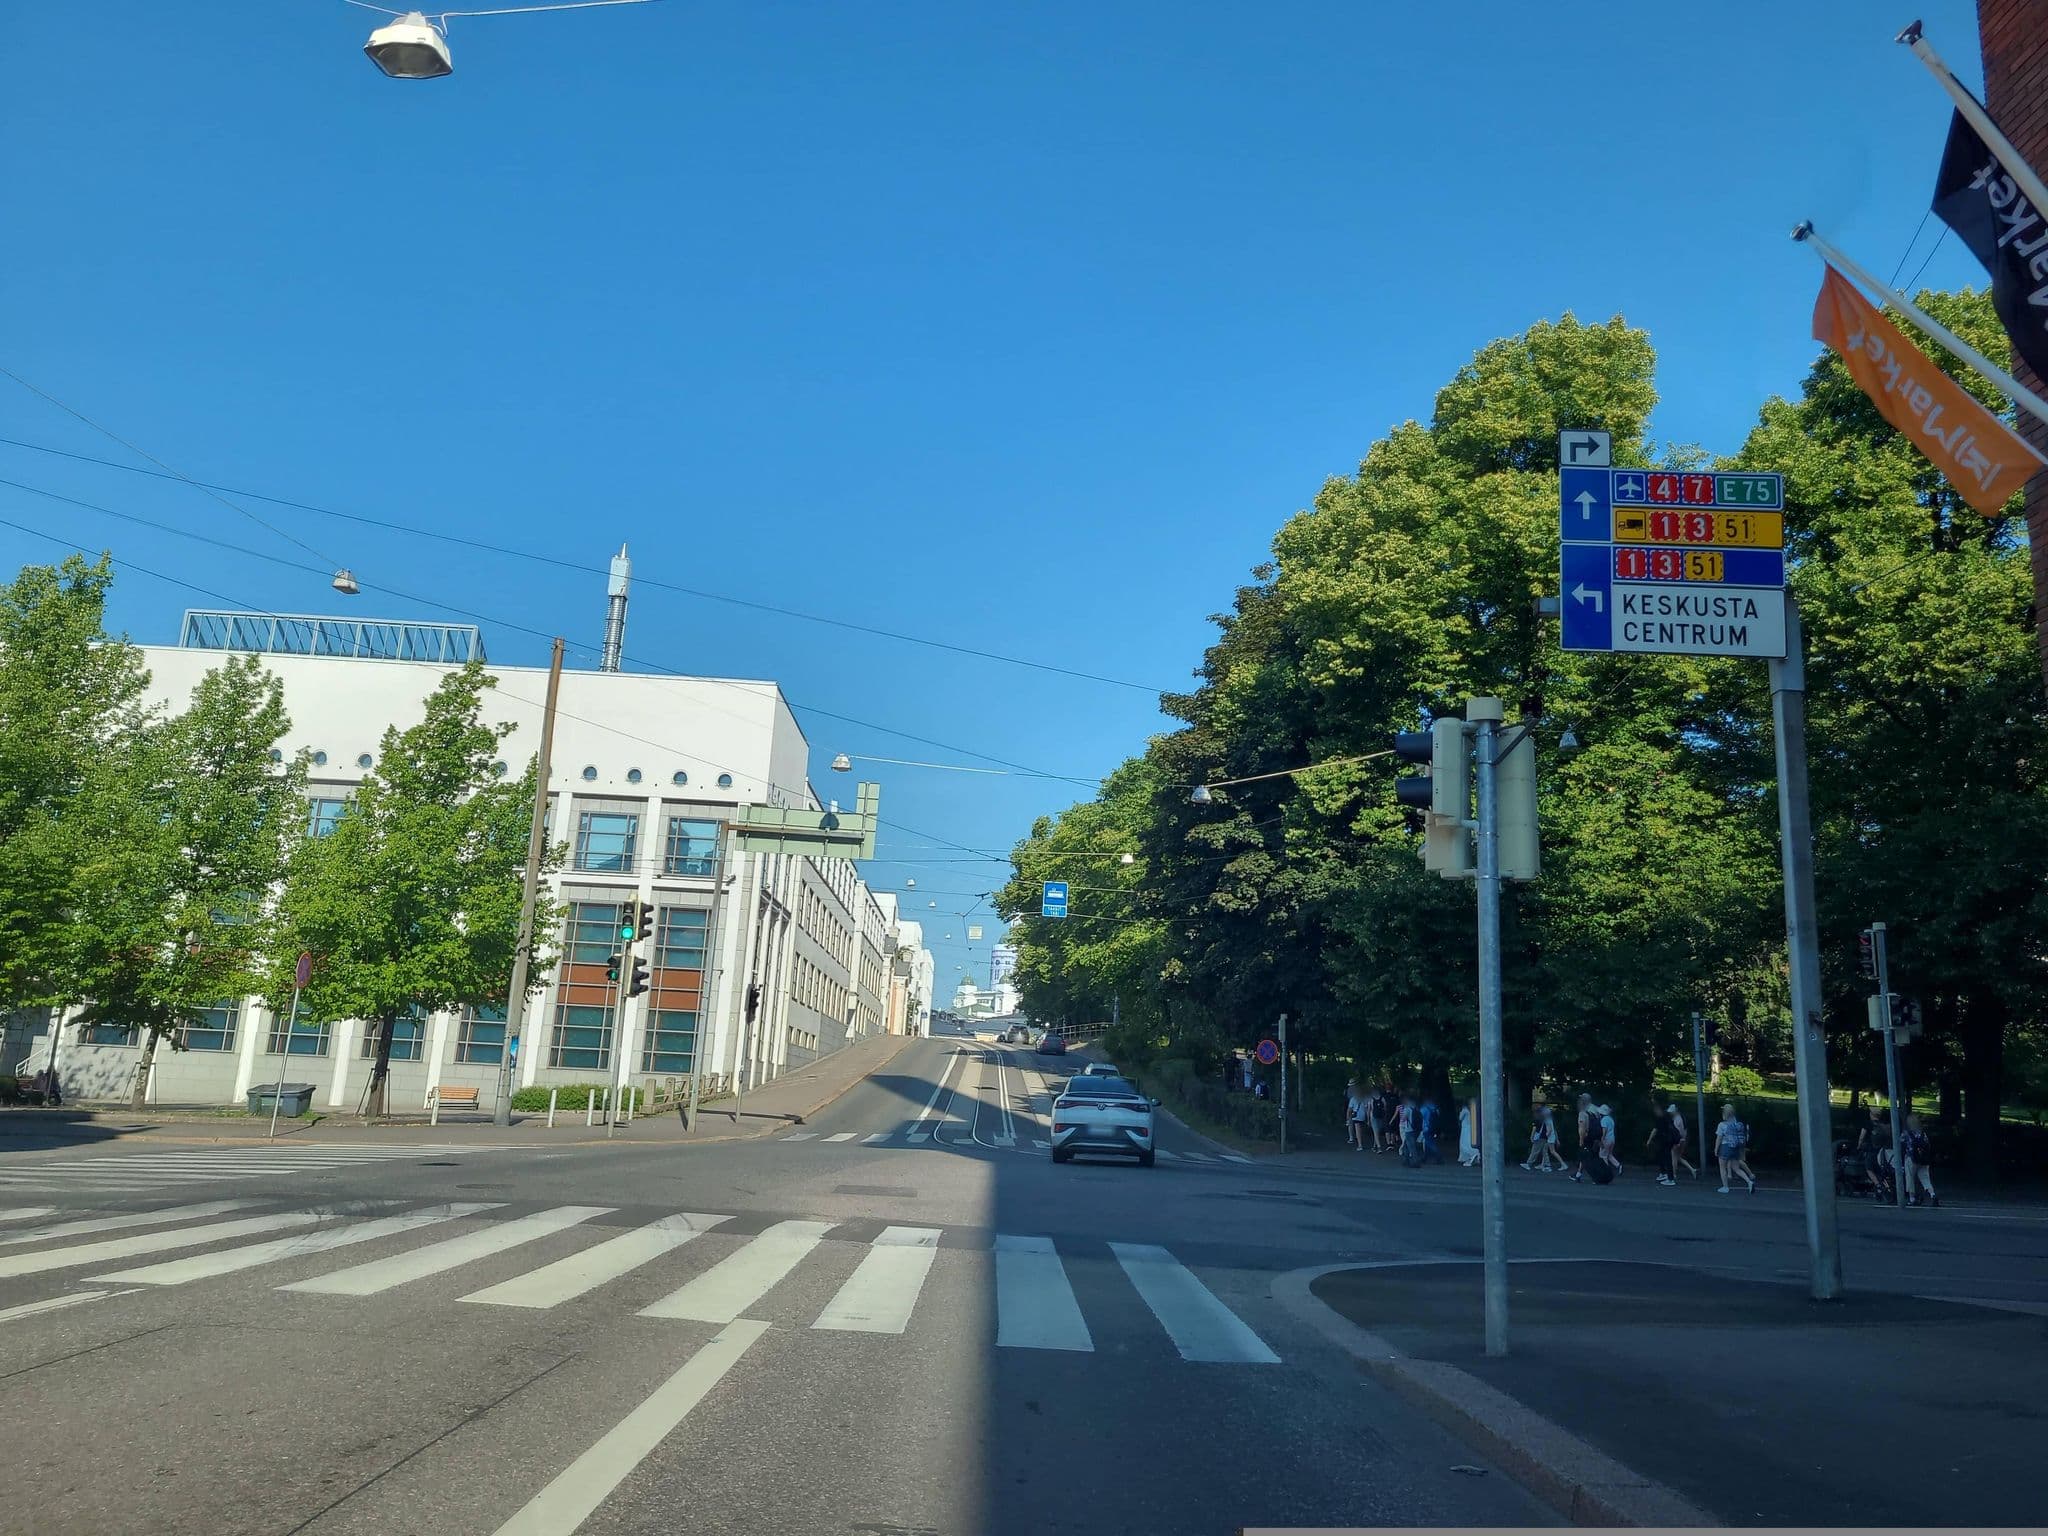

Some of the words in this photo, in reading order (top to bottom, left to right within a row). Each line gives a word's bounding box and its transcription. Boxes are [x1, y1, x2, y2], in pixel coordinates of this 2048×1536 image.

[1657, 479, 1670, 498] 4
[1692, 480, 1703, 499] 7
[1661, 517, 1669, 537] 1
[1693, 517, 1705, 537] 3
[1725, 519, 1749, 539] 51
[1628, 554, 1636, 574] 1
[1659, 555, 1672, 575] 3
[1692, 556, 1715, 577] 51
[1623, 594, 1758, 619] KESKUSTA
[1624, 622, 1748, 647] CENTRUM
